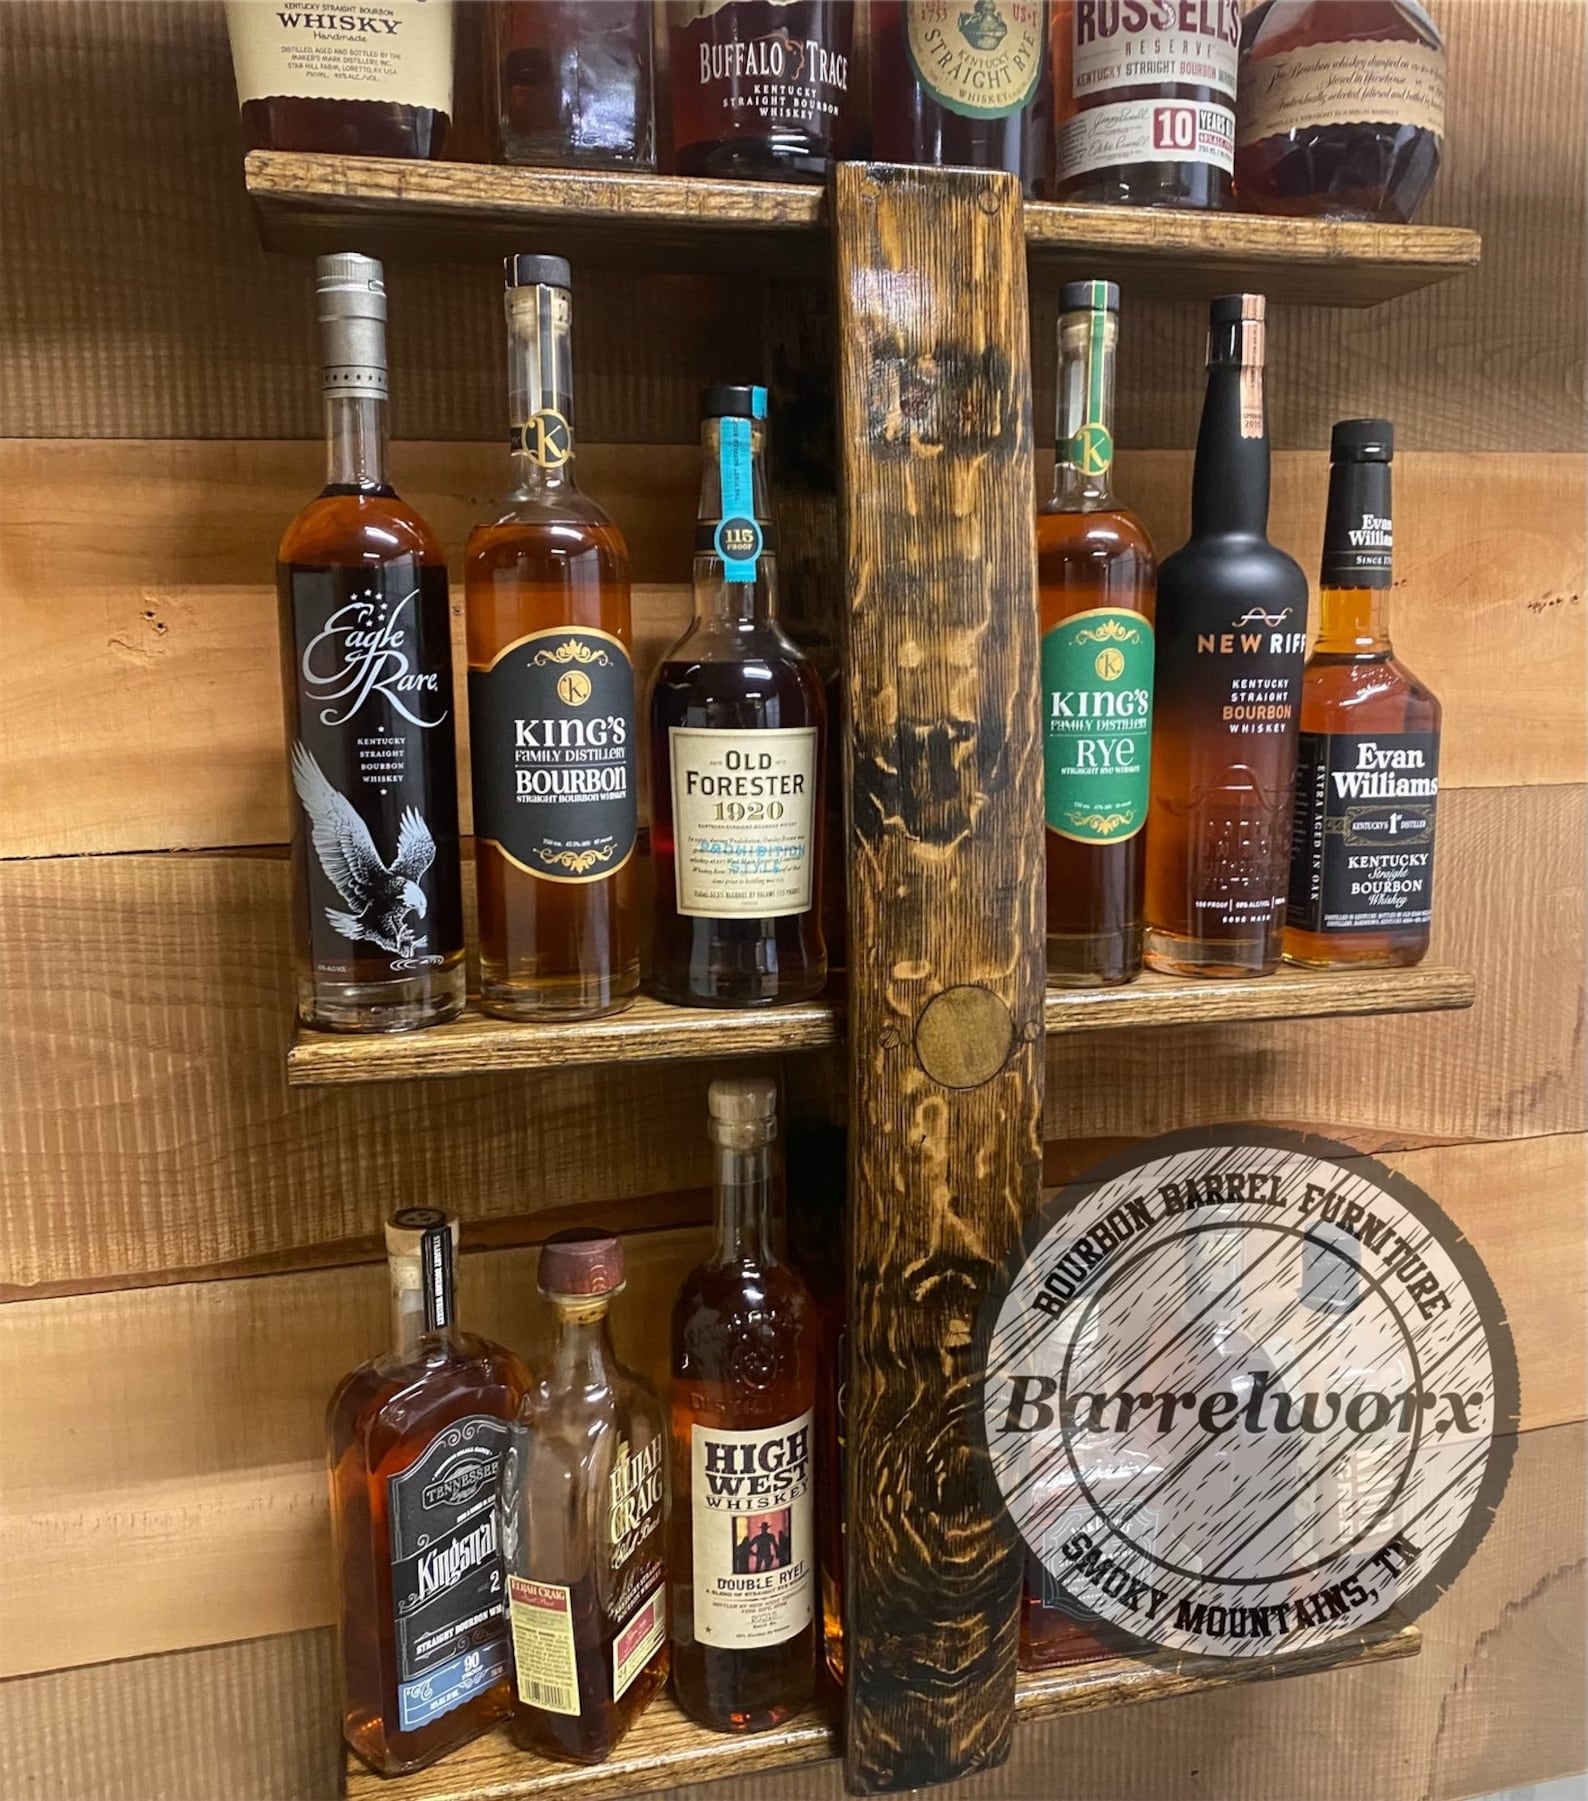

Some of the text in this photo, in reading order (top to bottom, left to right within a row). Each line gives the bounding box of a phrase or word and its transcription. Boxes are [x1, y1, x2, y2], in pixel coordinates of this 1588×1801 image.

[284, 3, 394, 16] KENTUCKY STRAIGHT BOURBON
[276, 12, 403, 35] WHISKY
[1077, 0, 1239, 48] RUSSELL'S
[314, 31, 366, 42] Handmade
[349, 49, 378, 57] BOTTLED
[925, 28, 1035, 89] STRAIGHT RYE
[1125, 39, 1212, 58] RESERVE
[699, 39, 849, 90] BUFFALO TRACE
[958, 51, 1009, 69] KENTUCKY
[1077, 64, 1122, 86] KENTUCKY
[1125, 60, 1176, 76] STRAIGHT
[1179, 62, 1217, 79] BOURBON
[753, 84, 817, 98] KENTUCKY
[958, 89, 1008, 104] WHISKEY
[723, 96, 839, 117] STRAIGHT BOURBON
[759, 106, 814, 121] WHISKEY
[1157, 109, 1193, 147] 10
[1200, 110, 1225, 135] YEARS
[725, 528, 754, 544] 115
[727, 543, 753, 551] PROOF
[1356, 555, 1382, 565] SINCE
[303, 589, 420, 700] Eagle
[1197, 633, 1307, 654] NEW RIFF
[320, 650, 448, 728] Rare
[1232, 679, 1289, 690] KENTUCKY
[1231, 692, 1288, 703] STRAIGHT
[1223, 704, 1292, 721] BOURBON
[1229, 723, 1286, 734] WHISKEY
[357, 737, 406, 746] KENTUCKY
[360, 749, 405, 758] STRAIGHT
[725, 750, 772, 771] OLD
[1355, 743, 1425, 770] Evan
[361, 762, 405, 770] BOURBON
[362, 775, 404, 783] WHISKEY
[515, 766, 627, 794] BOURBON
[686, 770, 804, 796] FORESTER
[1331, 771, 1438, 799] Williams
[516, 794, 558, 803] STRAIGHT
[558, 793, 599, 803] BOURBON
[713, 801, 784, 822] 1920
[1310, 764, 1326, 901] EXTRA AGED IN OAK
[1348, 853, 1429, 869] KENTUCKY
[1368, 865, 1410, 881] Straight
[1351, 879, 1424, 895] BOURBON
[1368, 893, 1408, 908] Whiskey
[704, 1424, 809, 1475] HIGH
[609, 1432, 663, 1511] ELIJAH
[705, 1456, 809, 1496] WEST
[706, 1478, 808, 1510] WHISKEY
[610, 1466, 663, 1545] CRAIG
[511, 1579, 538, 1595] ELIJAH
[538, 1586, 566, 1601] CRAIG
[717, 1575, 774, 1591] DOUBLE
[416, 1625, 455, 1655] STRAIGHT
[463, 1651, 480, 1672] 90
